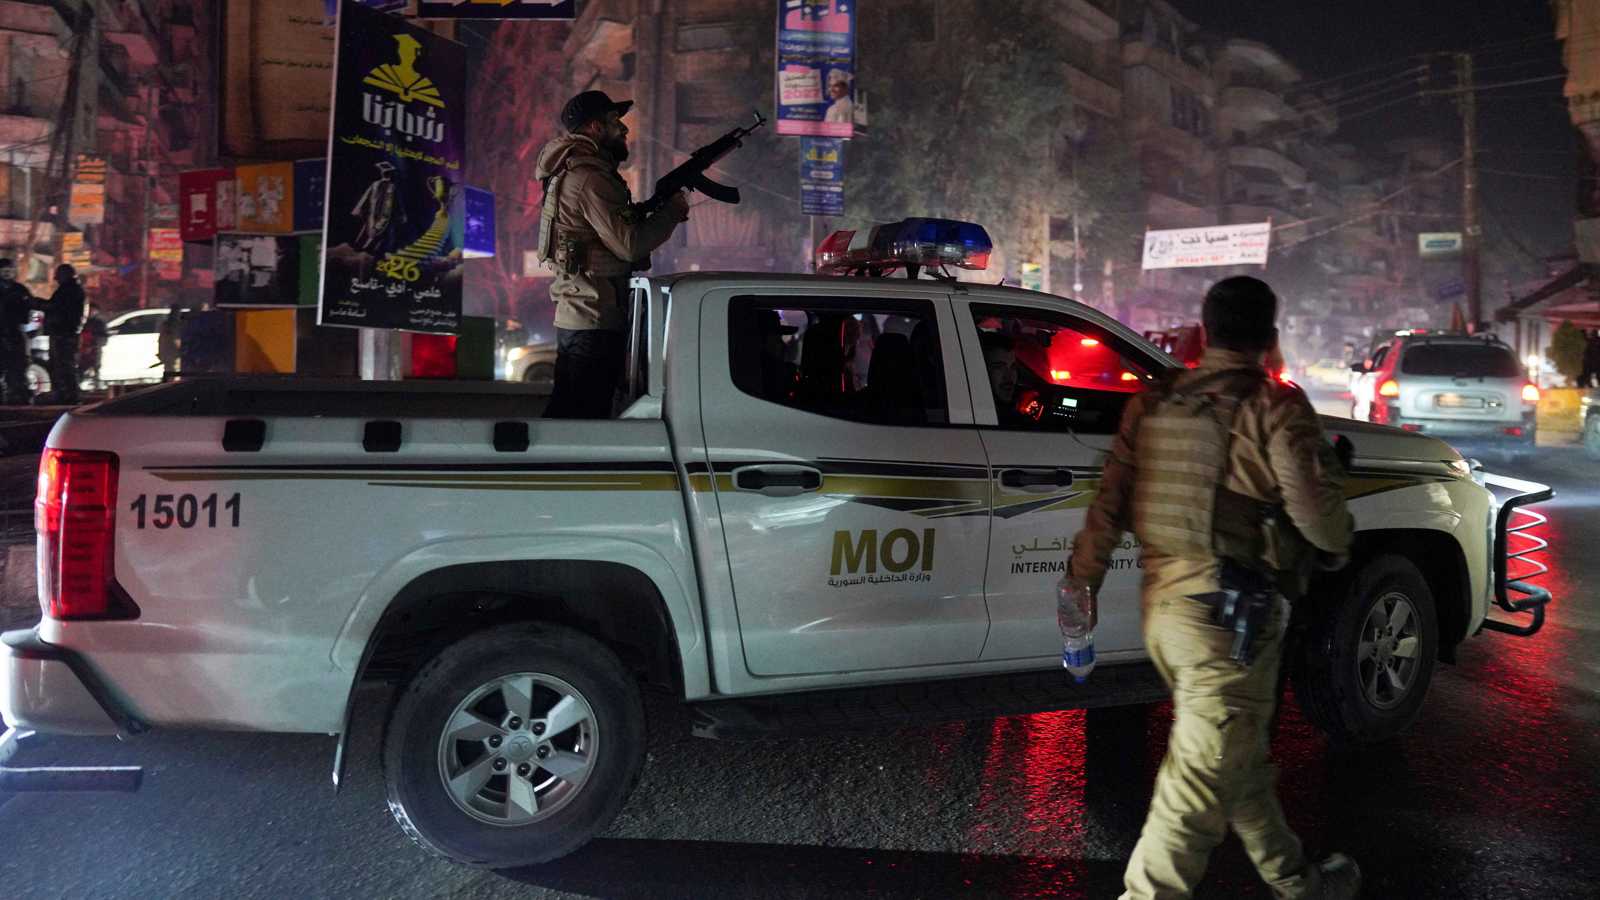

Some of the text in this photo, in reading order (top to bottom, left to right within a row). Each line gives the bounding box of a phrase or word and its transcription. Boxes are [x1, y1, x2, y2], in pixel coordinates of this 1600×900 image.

[363, 93, 445, 143] شبابنا
[130, 493, 241, 529] 15011
[830, 528, 936, 576] MOI
[1011, 561, 1065, 574] INTERNA
[827, 573, 931, 587] وزارة الداخلية السورية
